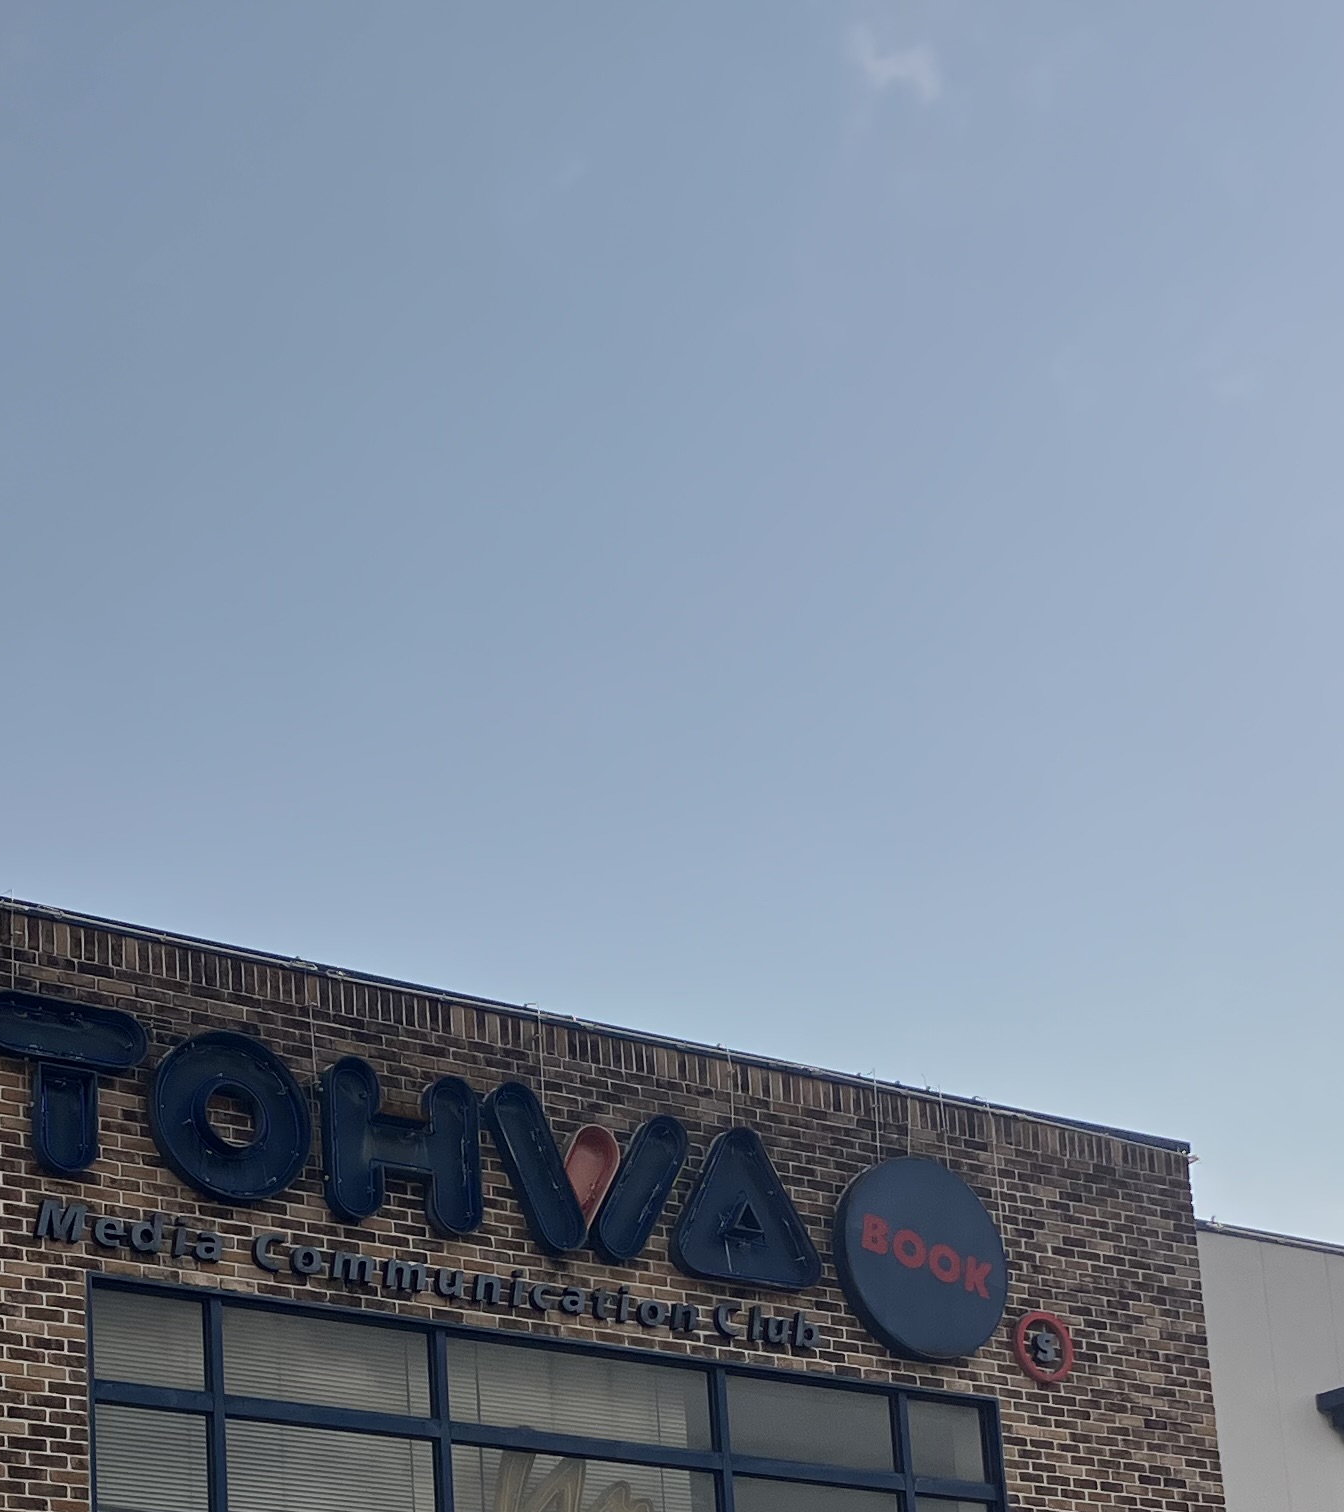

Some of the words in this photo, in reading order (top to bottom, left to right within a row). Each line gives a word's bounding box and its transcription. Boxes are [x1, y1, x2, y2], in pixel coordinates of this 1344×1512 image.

[35, 1196, 225, 1266] Media
[252, 1231, 701, 1335] Communication
[712, 1298, 821, 1352] Club
[862, 1212, 994, 1301] BOOK
